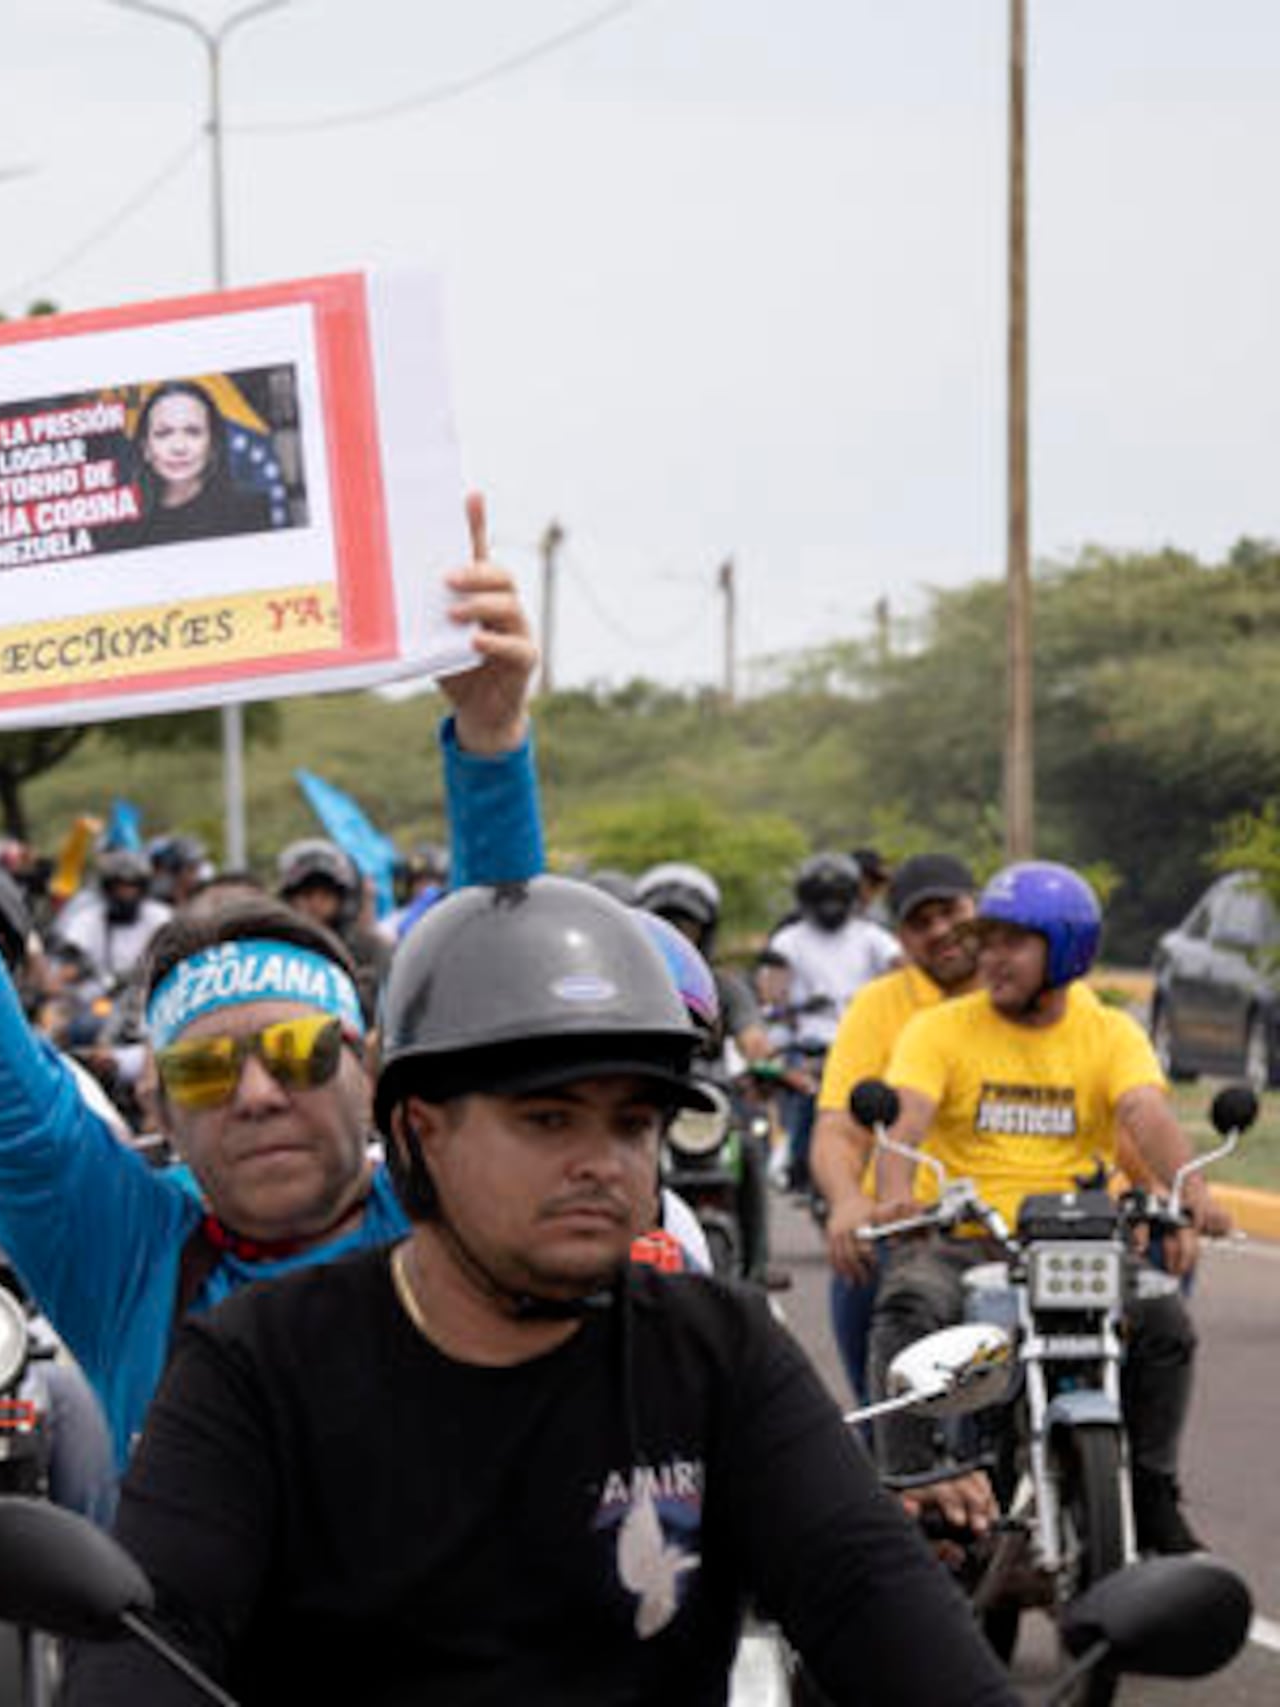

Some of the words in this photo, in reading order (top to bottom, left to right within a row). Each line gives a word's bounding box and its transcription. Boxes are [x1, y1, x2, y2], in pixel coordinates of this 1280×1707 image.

[0, 419, 29, 447] LA
[32, 404, 124, 442] PRESIÓN
[84, 461, 116, 490] DE
[36, 487, 140, 532] CORINA
